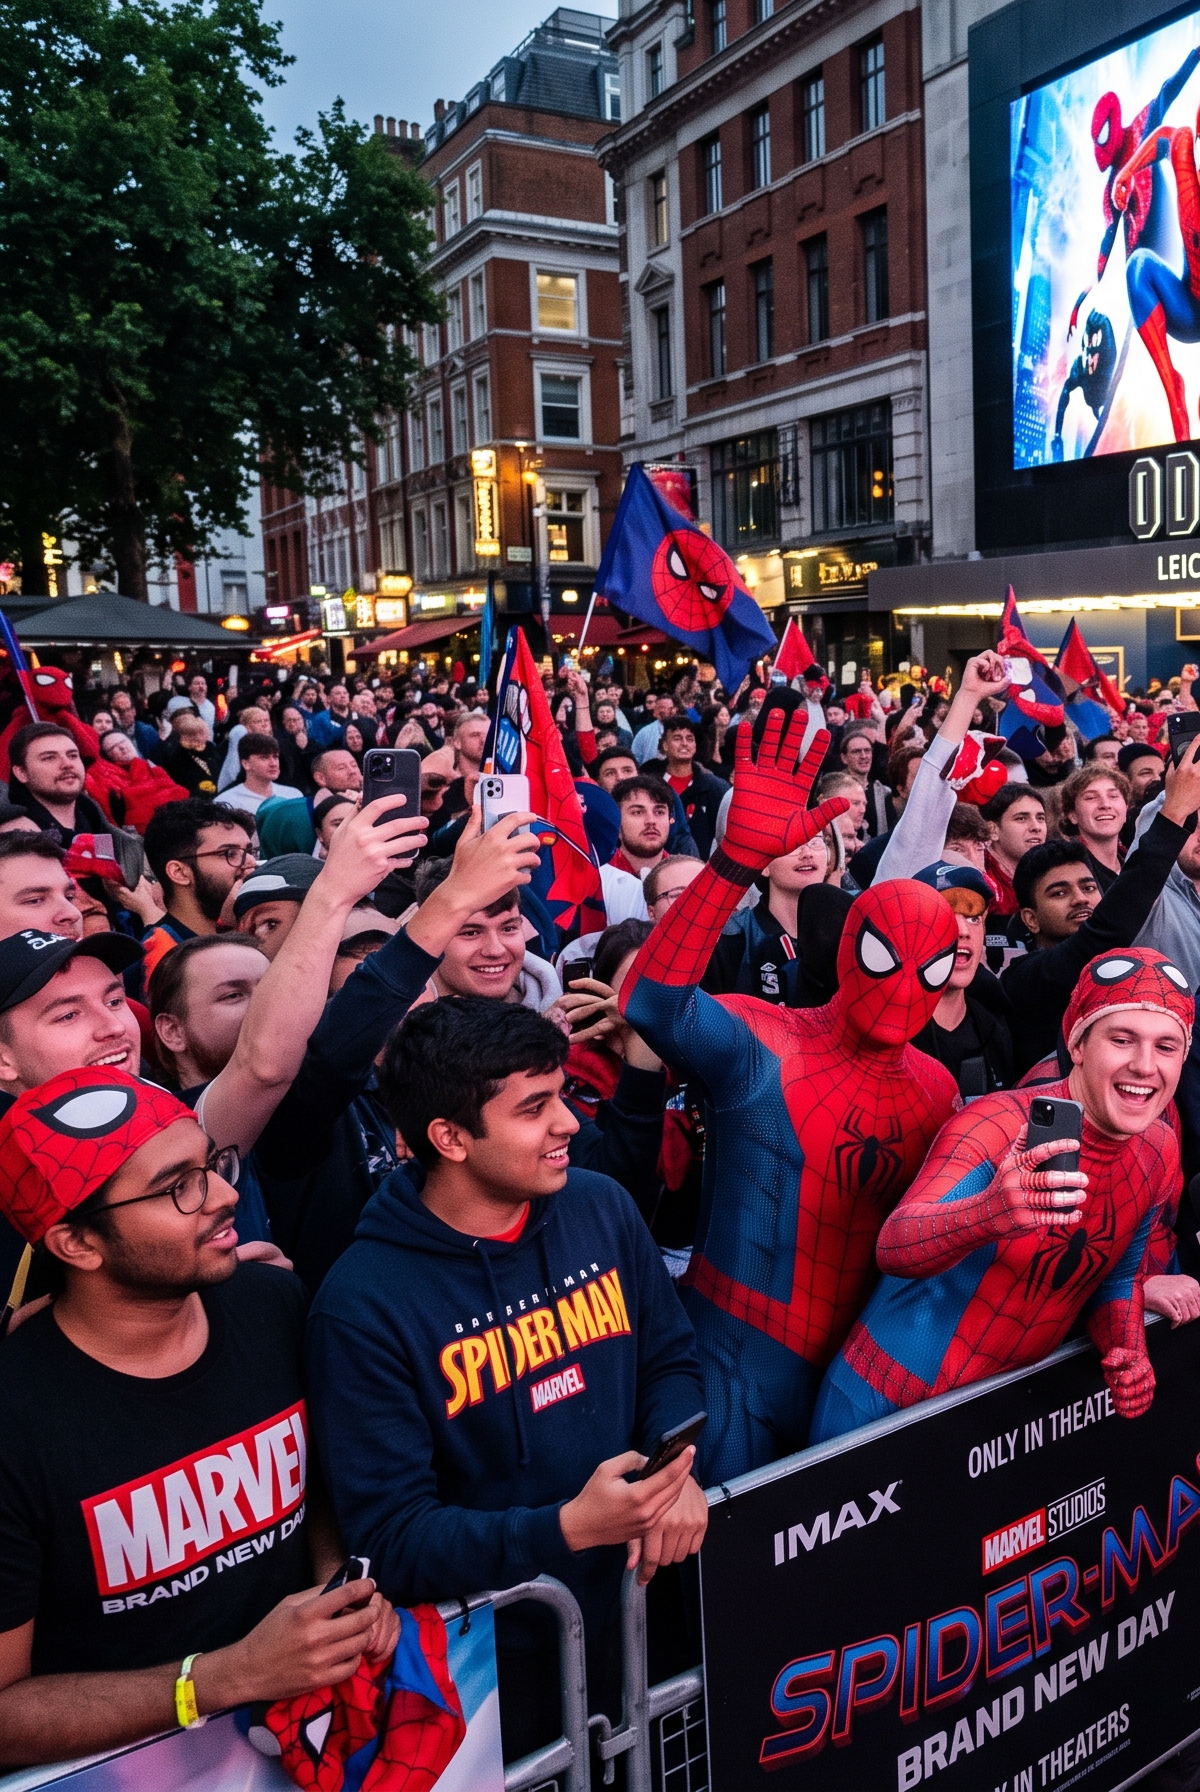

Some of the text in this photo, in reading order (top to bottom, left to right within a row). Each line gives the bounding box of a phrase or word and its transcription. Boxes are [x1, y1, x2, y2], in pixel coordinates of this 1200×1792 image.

[531, 1367, 584, 1410] MARVEL
[968, 1388, 1116, 1479] ONLY IN THEATE
[774, 1481, 901, 1566] IMAX
[984, 1483, 1106, 1571] MARVEL STUDIOS
[102, 1565, 210, 1615] BRAND
[215, 1530, 275, 1573] NEW
[897, 1685, 1025, 1792] BRAND
[1034, 1630, 1109, 1712] NEW
[1117, 1590, 1176, 1660] DAY
[1038, 1703, 1130, 1787] THEATERS
